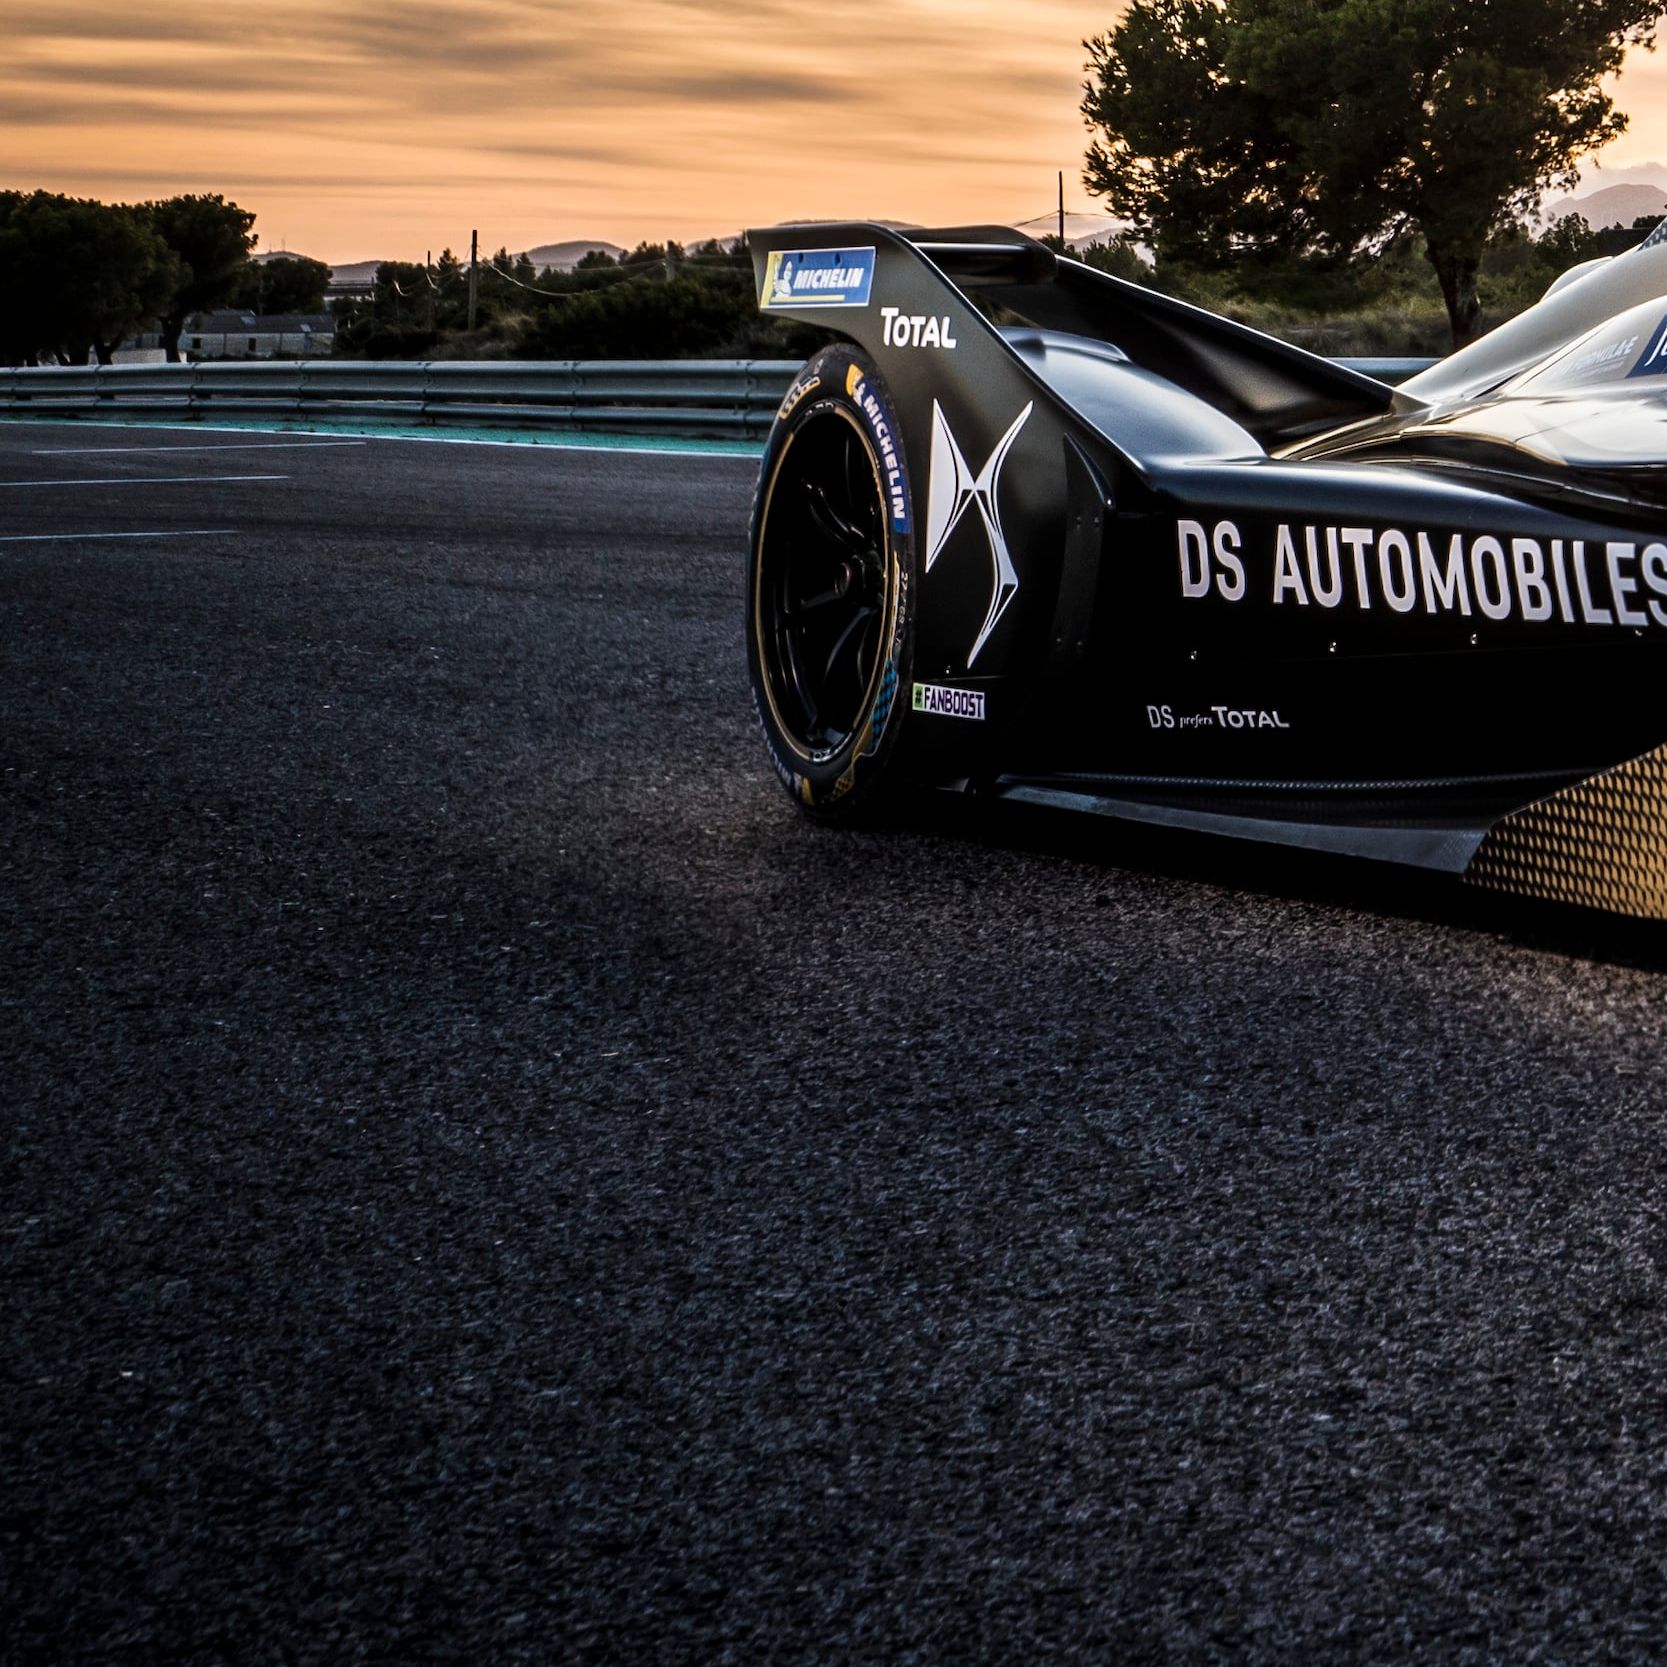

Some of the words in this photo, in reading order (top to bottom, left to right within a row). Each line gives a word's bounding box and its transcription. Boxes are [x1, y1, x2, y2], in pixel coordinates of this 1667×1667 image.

[793, 268, 864, 289] MICHELIN
[880, 307, 957, 349] TOTAL
[863, 394, 905, 519] MICHELIN
[1177, 519, 1246, 602] DS
[915, 686, 984, 718] #FANBOOST
[1146, 705, 1175, 728] DS
[1180, 714, 1213, 728] prefers
[1211, 706, 1290, 728] TOTAL
